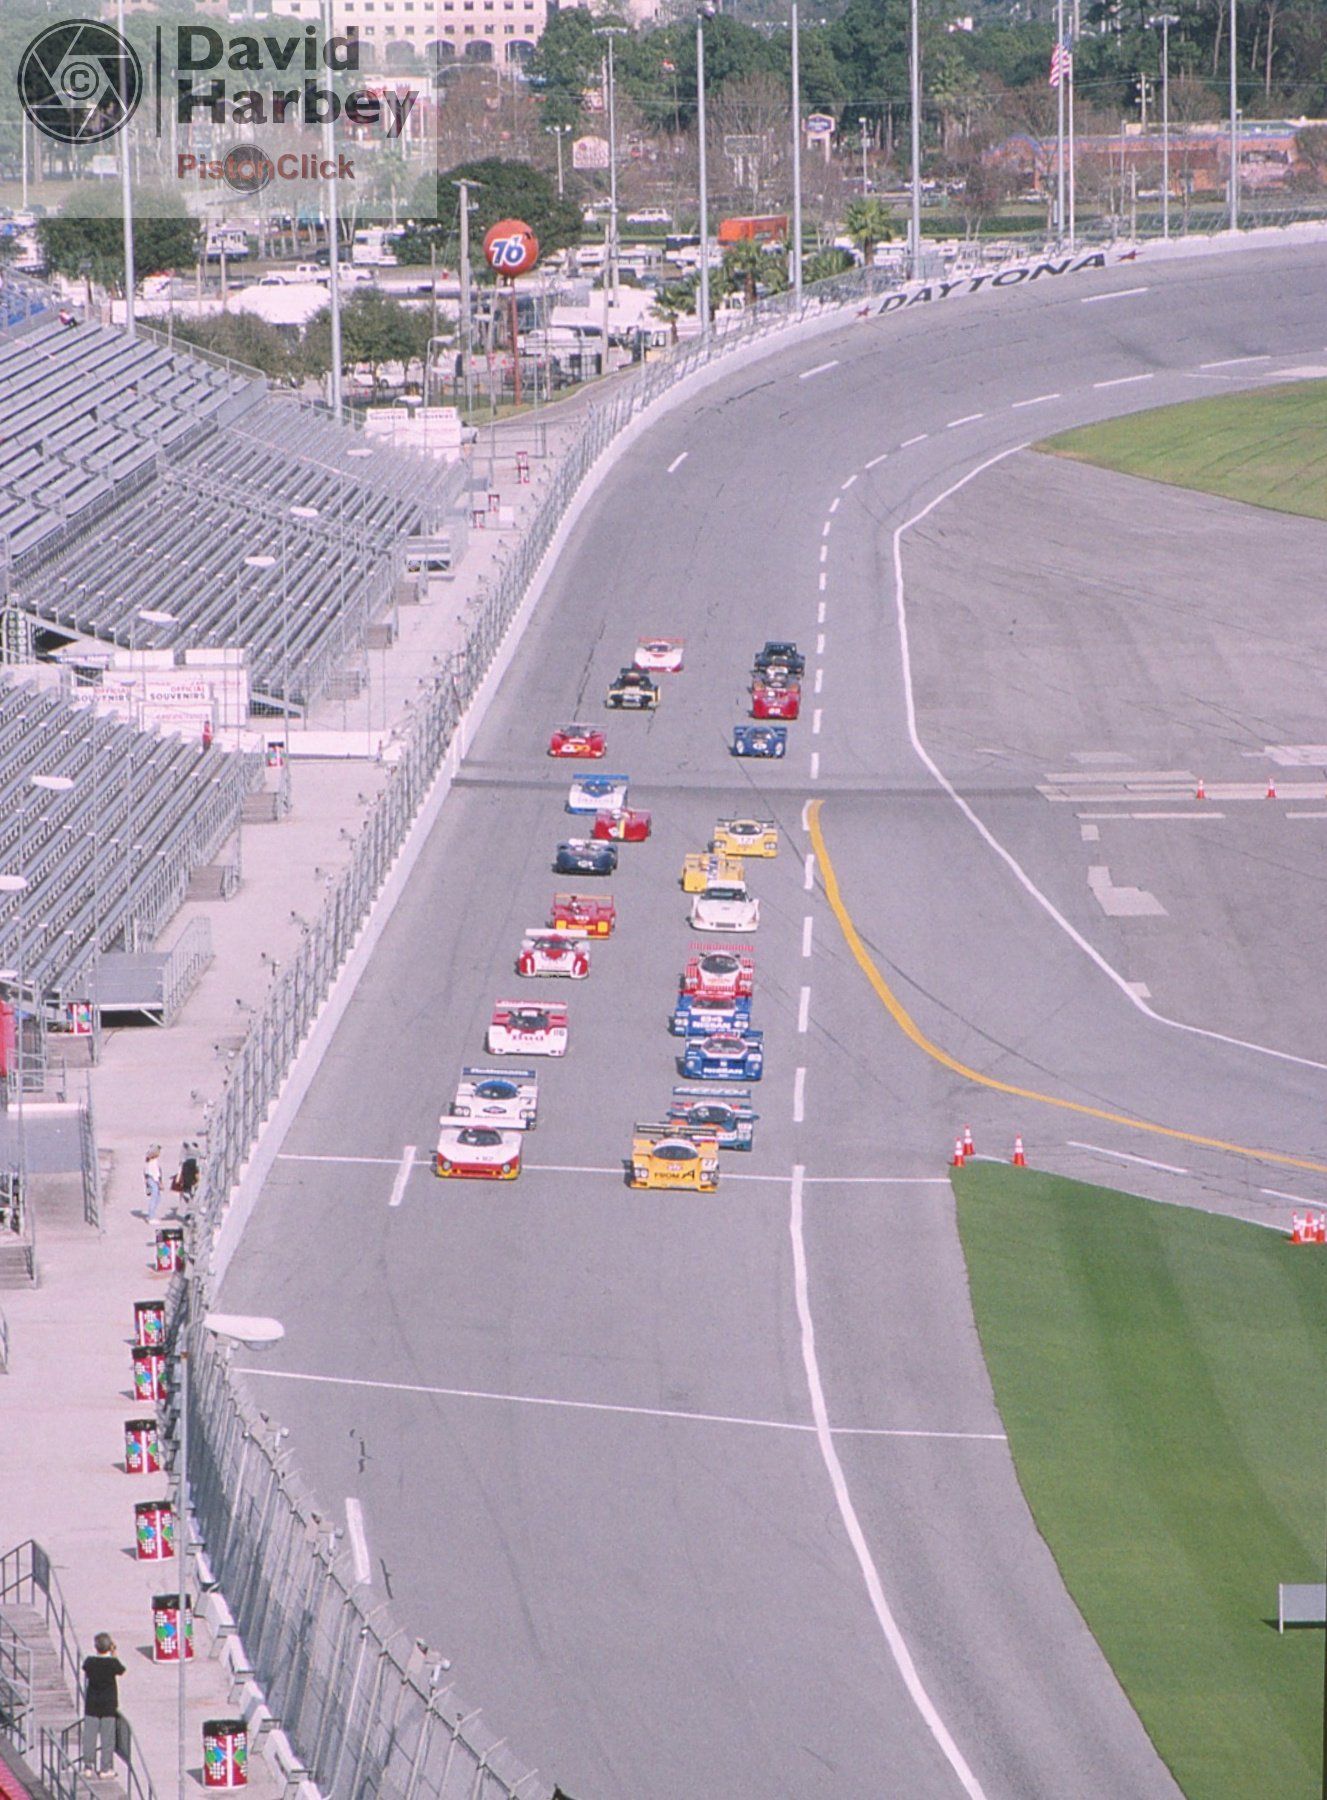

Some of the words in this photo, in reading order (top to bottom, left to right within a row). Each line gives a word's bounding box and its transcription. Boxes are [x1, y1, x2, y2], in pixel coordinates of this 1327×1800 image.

[489, 235, 526, 267] 76
[877, 252, 1106, 315] DAYTONA
[149, 693, 206, 701] SOUVENIRS
[654, 1172, 680, 1180] FROM
[681, 1169, 695, 1180] A
